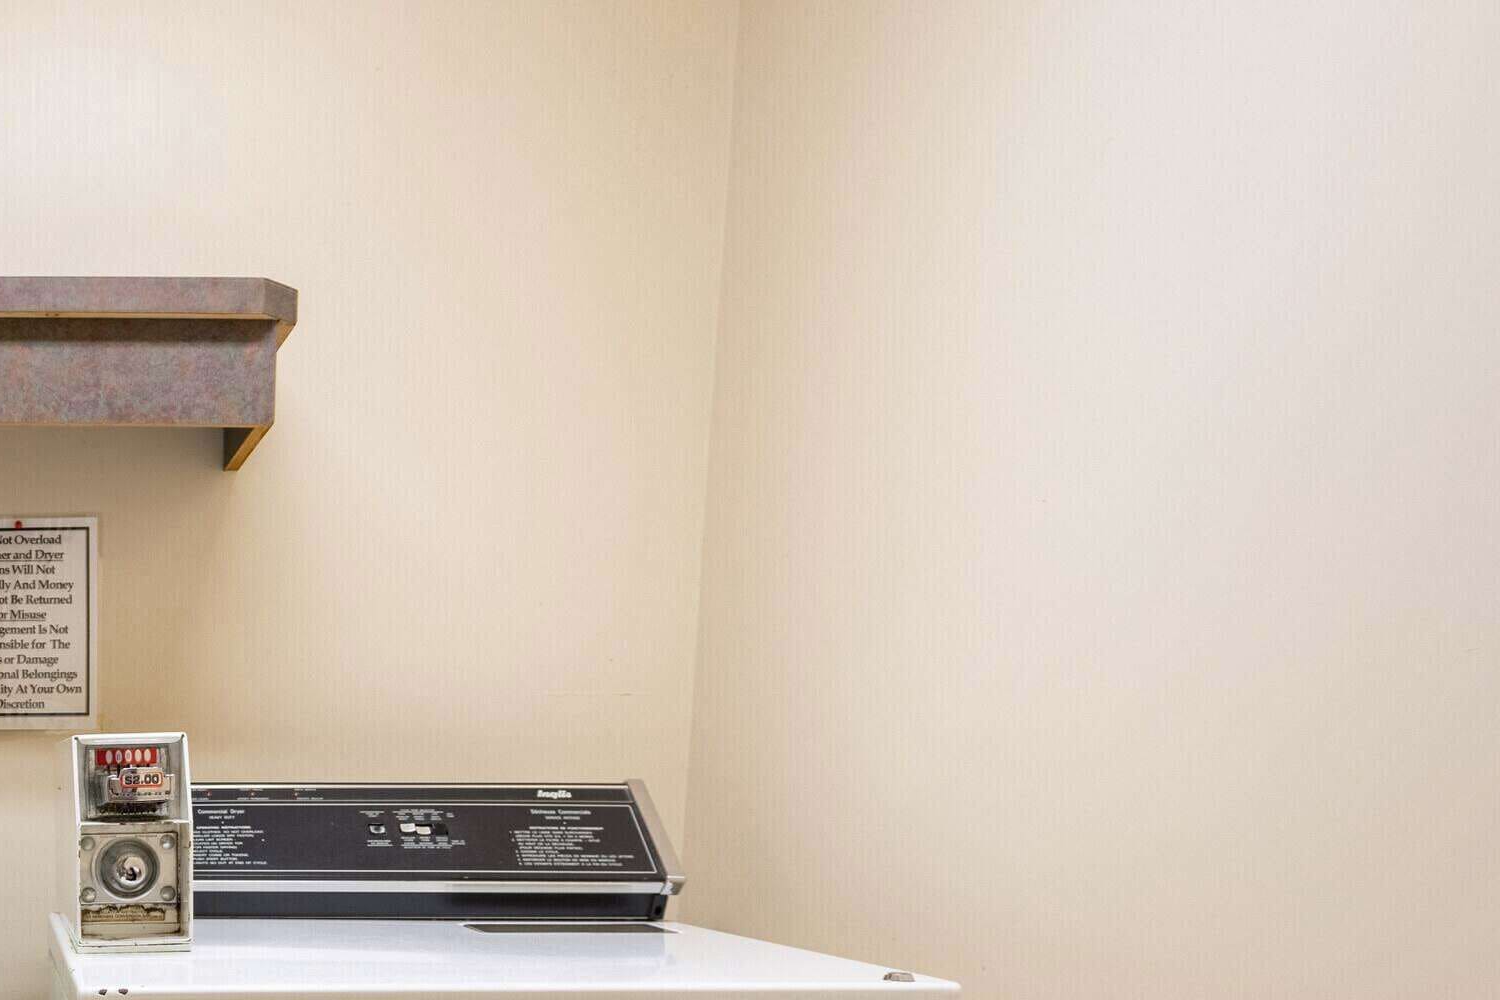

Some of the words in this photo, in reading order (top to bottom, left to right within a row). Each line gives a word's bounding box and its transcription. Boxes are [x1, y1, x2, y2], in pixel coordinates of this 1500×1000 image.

[14, 535, 62, 545] Overload
[13, 550, 32, 560] and
[34, 550, 64, 561] Dryer
[11, 565, 34, 575] Will
[35, 565, 55, 575] Not
[13, 580, 36, 590] And
[38, 580, 74, 591] Money
[11, 595, 23, 605] Be
[25, 595, 73, 605] Returned
[10, 610, 47, 619] Misuse
[38, 625, 48, 635] Is
[49, 625, 69, 634] Not
[31, 640, 46, 650] for
[51, 640, 71, 650] The
[4, 657, 14, 665] or
[16, 654, 59, 667] Damage
[21, 669, 78, 682] Belongings
[15, 684, 28, 694] At
[29, 684, 54, 694] Your
[56, 684, 82, 694] Own
[124, 773, 160, 785] $2.00
